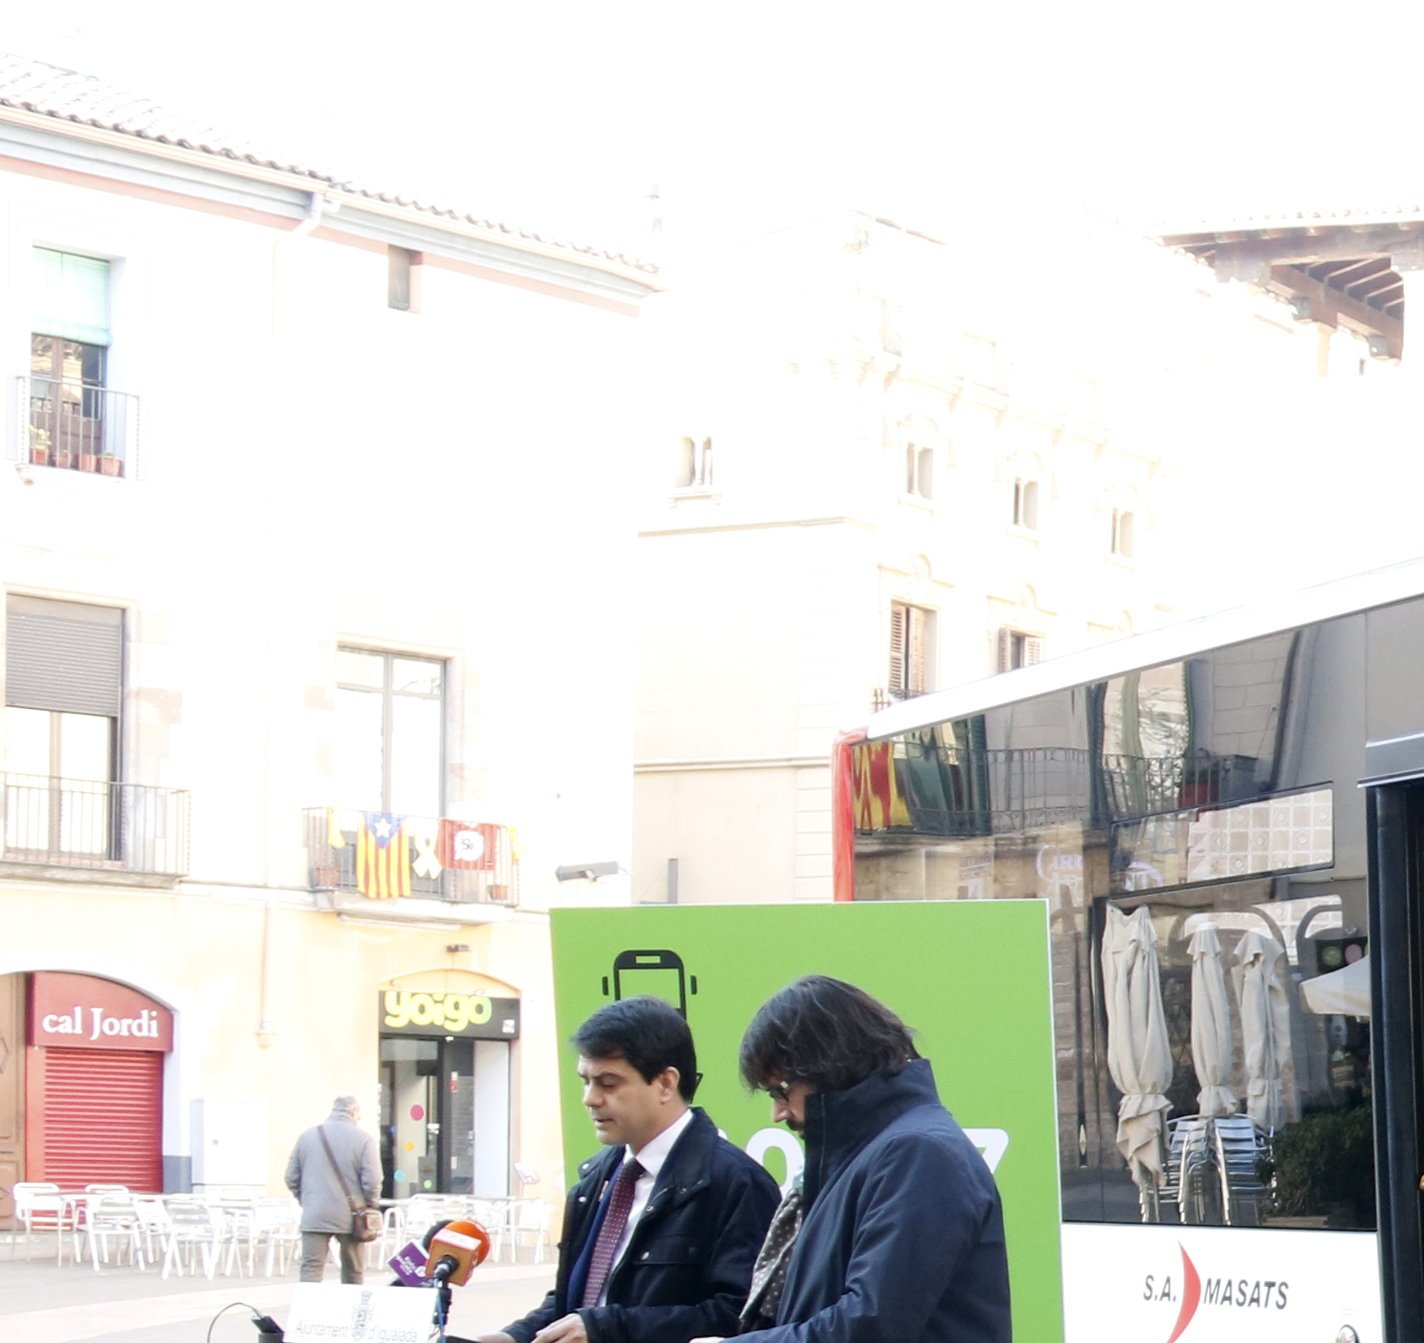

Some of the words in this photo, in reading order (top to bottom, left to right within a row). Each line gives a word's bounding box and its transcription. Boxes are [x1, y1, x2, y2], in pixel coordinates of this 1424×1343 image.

[42, 1006, 83, 1034] cal
[89, 1007, 159, 1041] Jordi
[384, 990, 493, 1032] yoigo
[1143, 1274, 1177, 1302] S.A.
[1203, 1278, 1289, 1310] MASATS
[295, 1320, 349, 1338] Ajuntament
